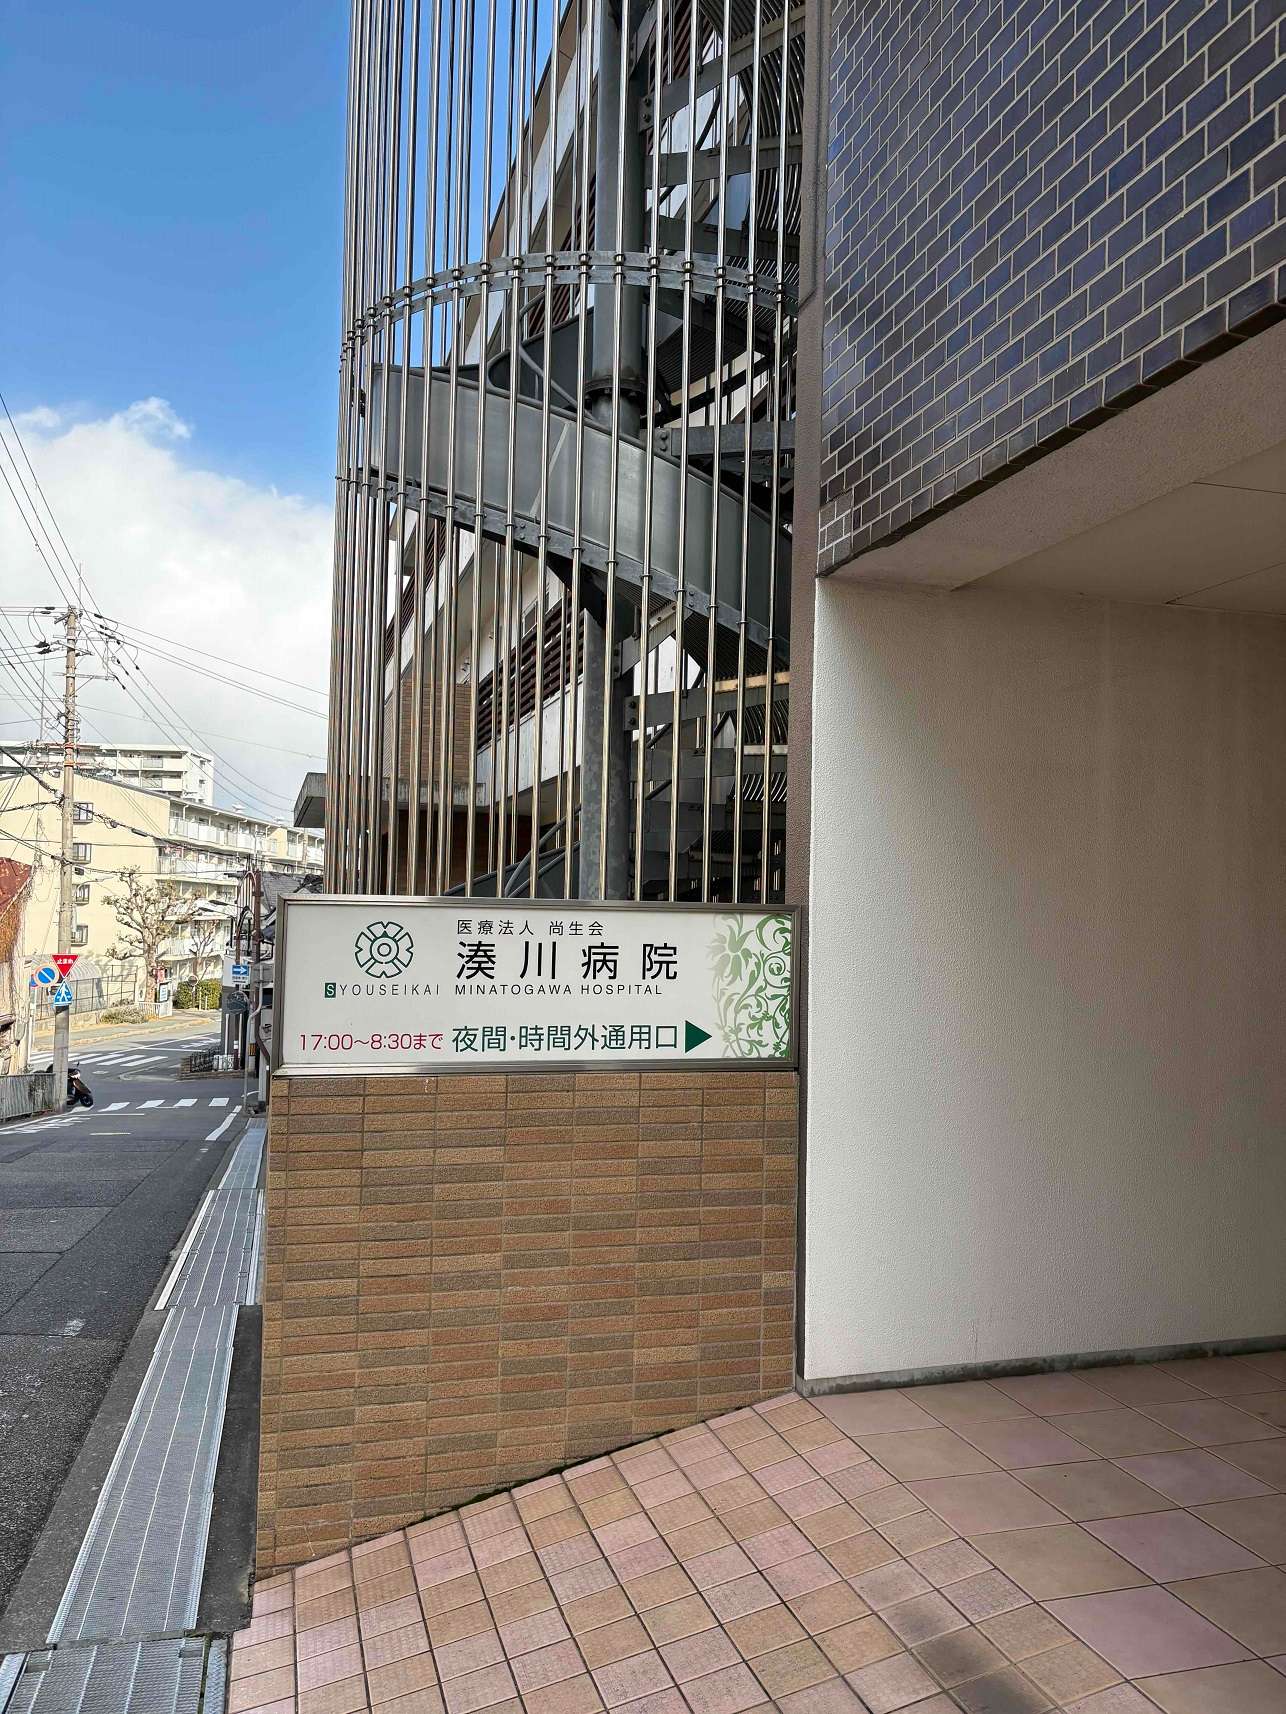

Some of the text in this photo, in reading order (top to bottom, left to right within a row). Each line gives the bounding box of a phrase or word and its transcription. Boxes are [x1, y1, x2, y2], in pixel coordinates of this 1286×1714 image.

[457, 919, 604, 937] 医療法人 尚生会
[456, 940, 678, 980] 湊川病院
[324, 982, 440, 999] SYOUSEIKAI
[455, 984, 663, 996] MINATOGAWA HOSPITAL
